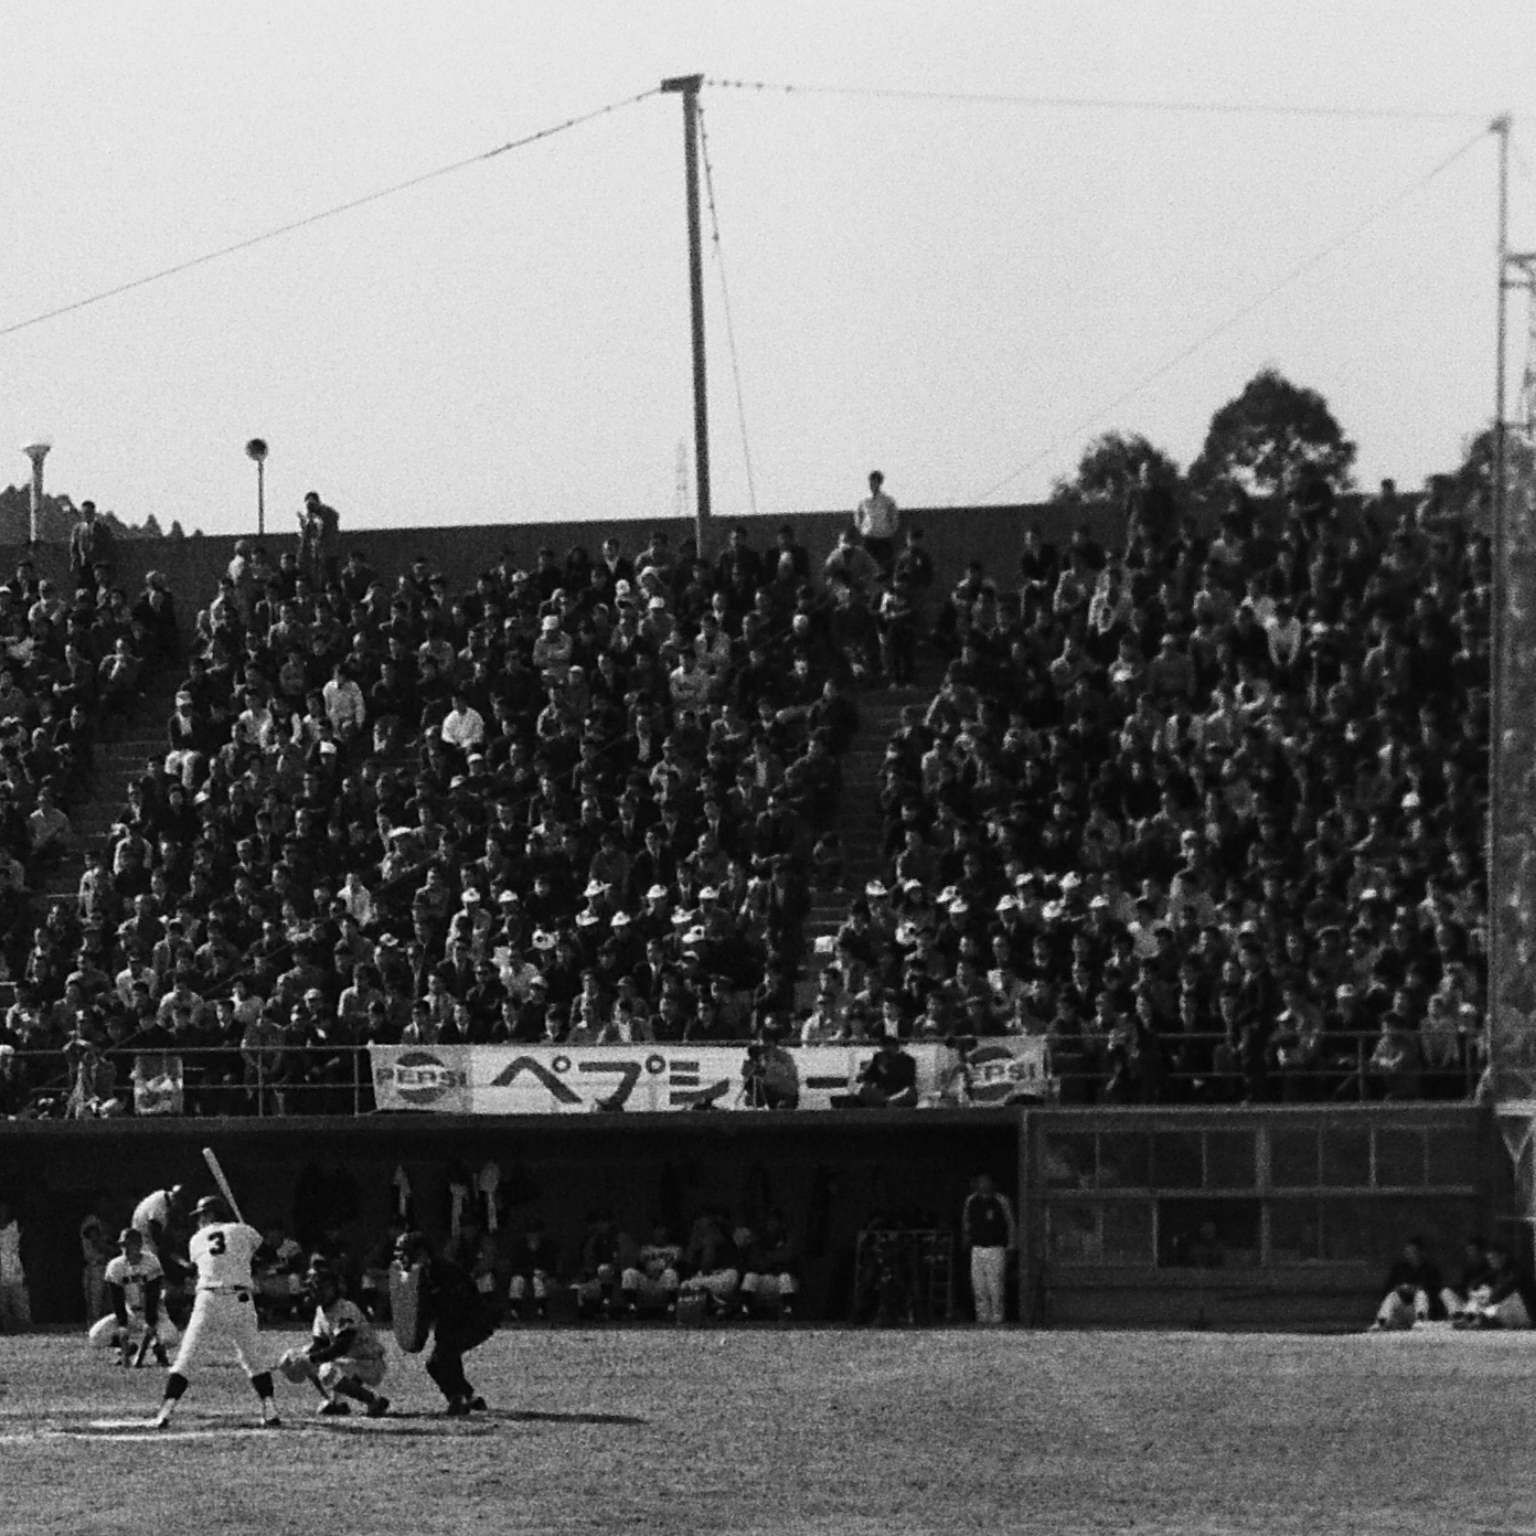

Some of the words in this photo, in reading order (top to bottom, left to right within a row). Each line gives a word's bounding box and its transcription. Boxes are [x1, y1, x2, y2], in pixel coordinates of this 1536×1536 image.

[376, 1066, 467, 1089] PEPSI
[490, 1053, 878, 1110] ペプシー
[969, 1062, 1036, 1083] EPSI
[208, 1230, 226, 1256] 3
